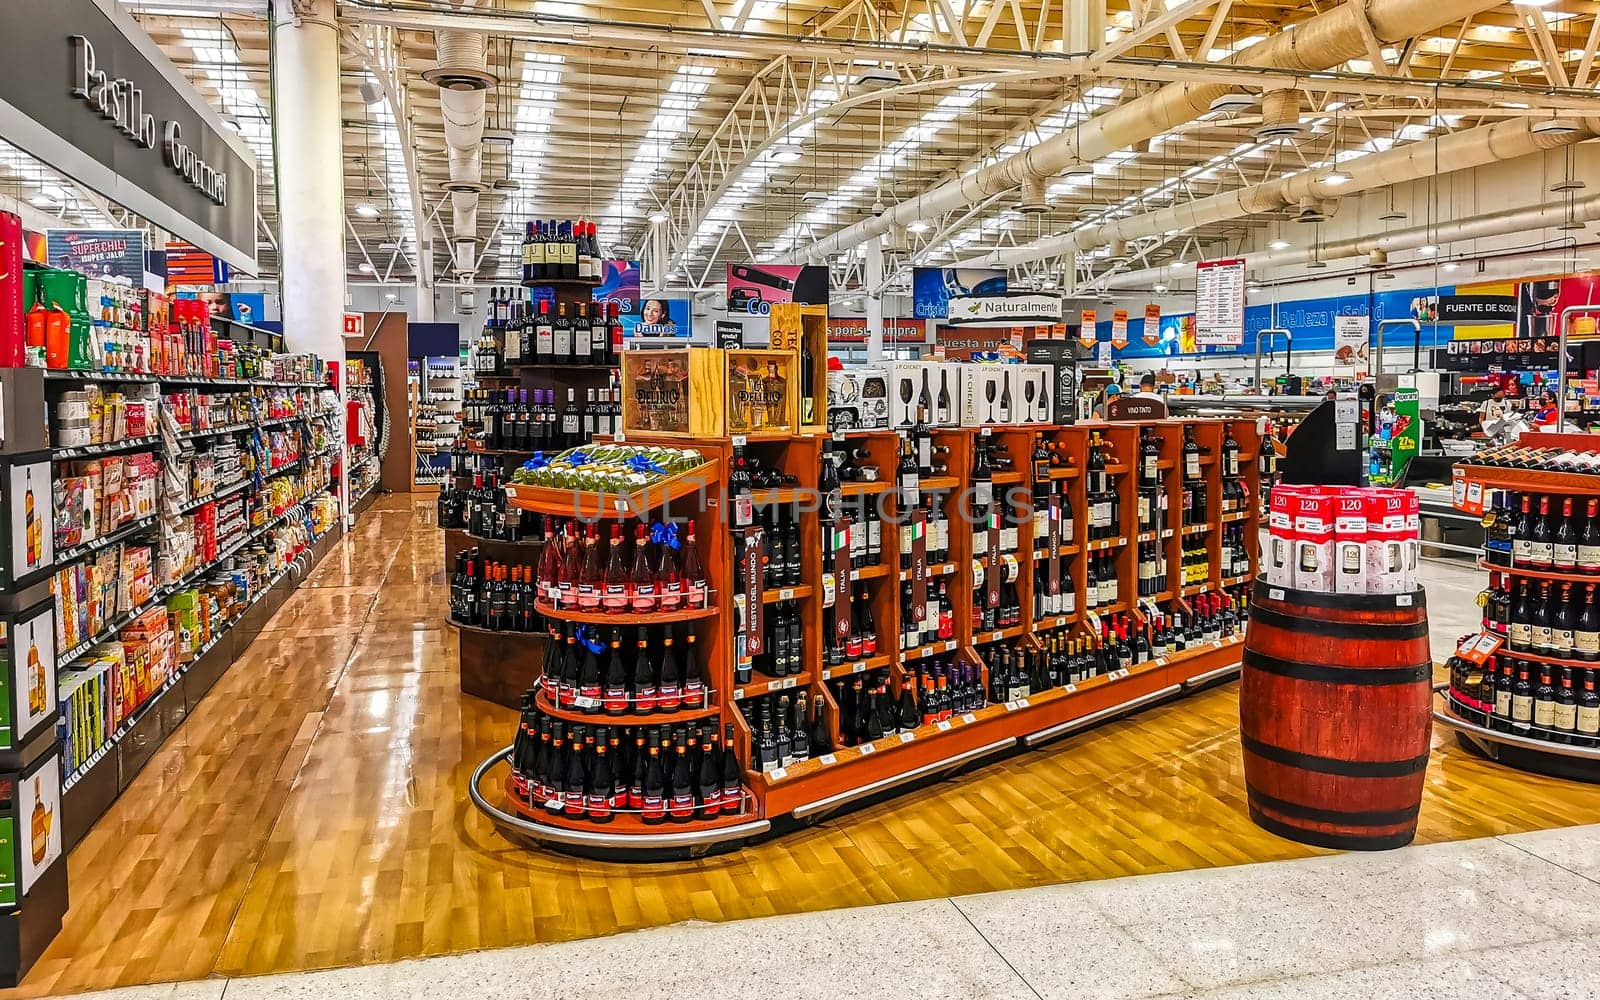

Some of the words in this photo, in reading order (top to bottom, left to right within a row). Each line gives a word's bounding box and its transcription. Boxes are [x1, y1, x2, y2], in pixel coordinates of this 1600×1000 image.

[70, 35, 156, 149] Pasillo
[164, 120, 227, 207] Gourmet
[72, 242, 101, 256] SUPER
[985, 301, 1058, 313] Naturalmente
[1446, 303, 1483, 312] FUENTE
[1485, 303, 1497, 312] DE
[1280, 310, 1329, 328] Belleza
[835, 326, 855, 337] por
[881, 326, 917, 337] ompra
[1274, 495, 1287, 506] 120
[1300, 500, 1319, 511] 120
[1340, 500, 1362, 511] 120
[1386, 498, 1401, 509] 120
[1346, 550, 1359, 559] 120
